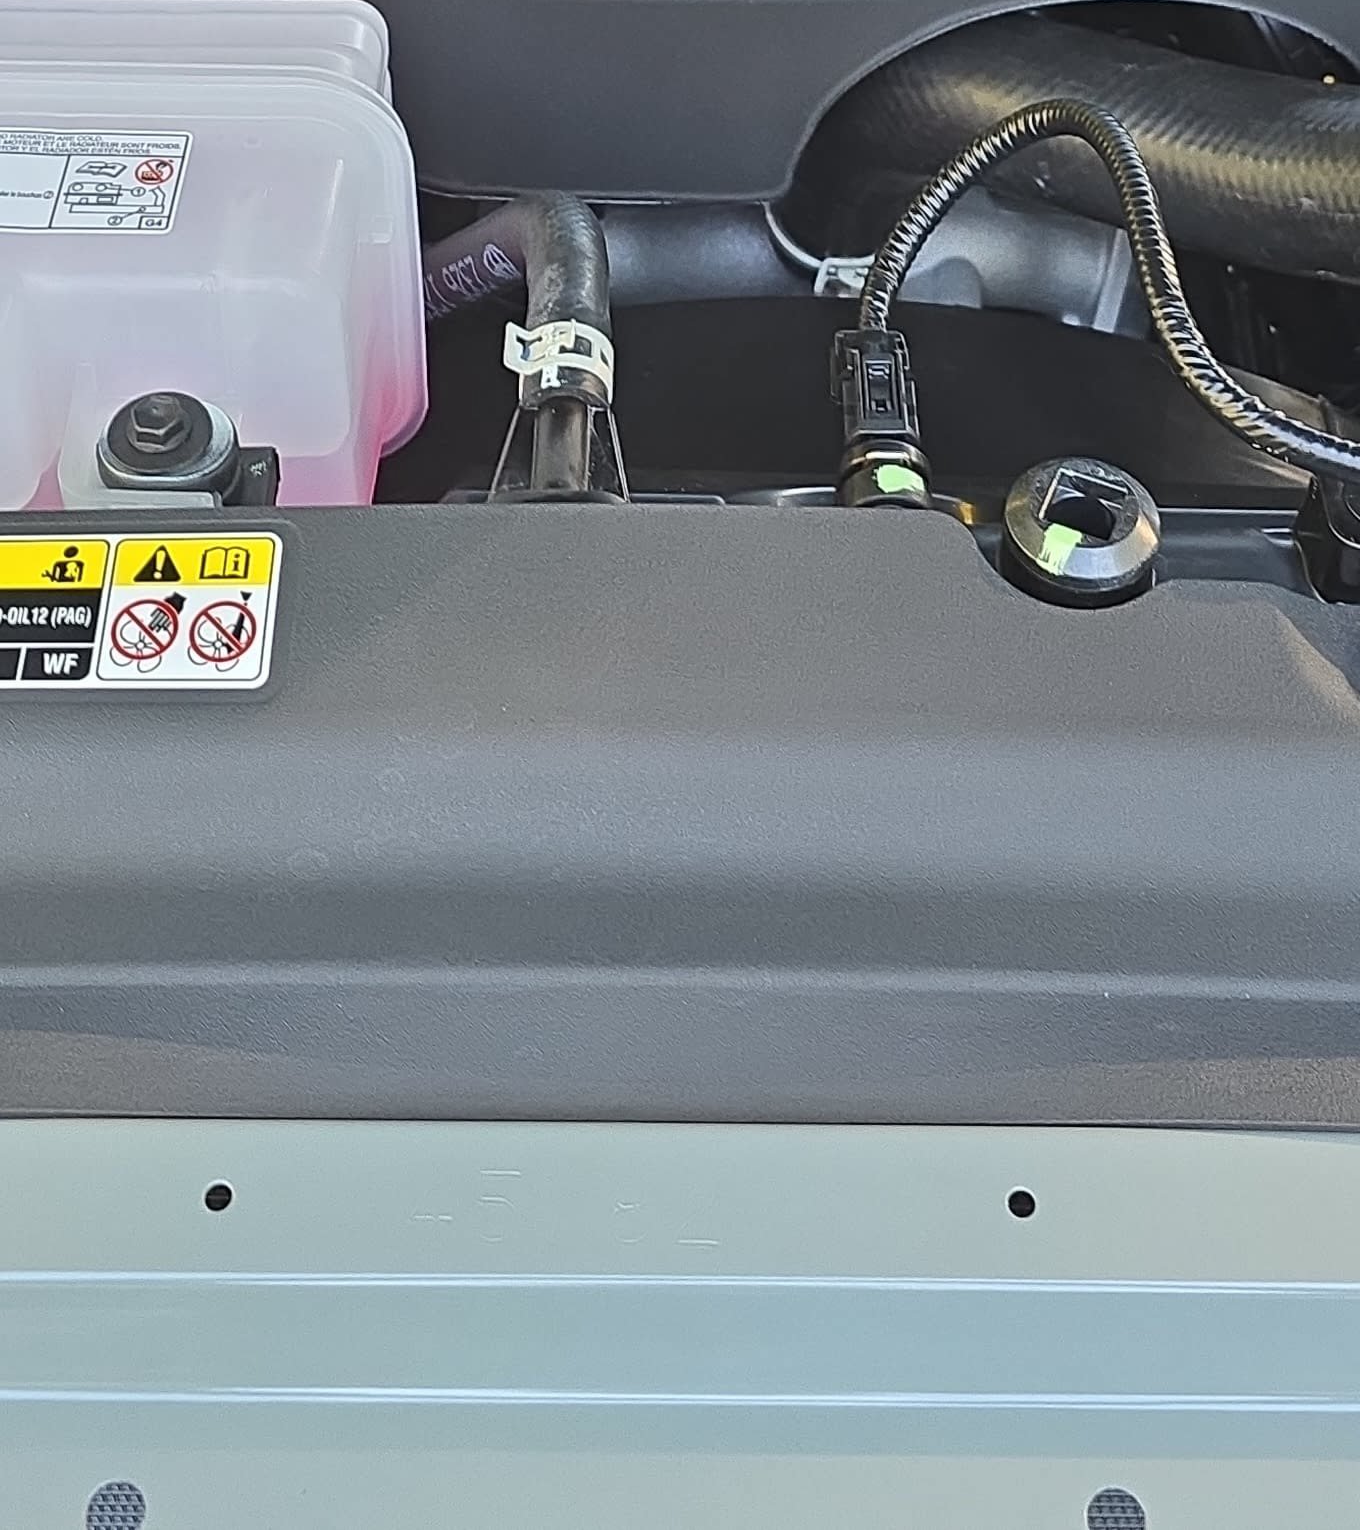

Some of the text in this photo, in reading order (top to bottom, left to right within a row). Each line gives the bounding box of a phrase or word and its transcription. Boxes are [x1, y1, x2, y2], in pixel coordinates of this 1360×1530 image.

[144, 218, 163, 227] G4
[51, 606, 92, 629] (PAG)
[43, 652, 80, 676] WF
